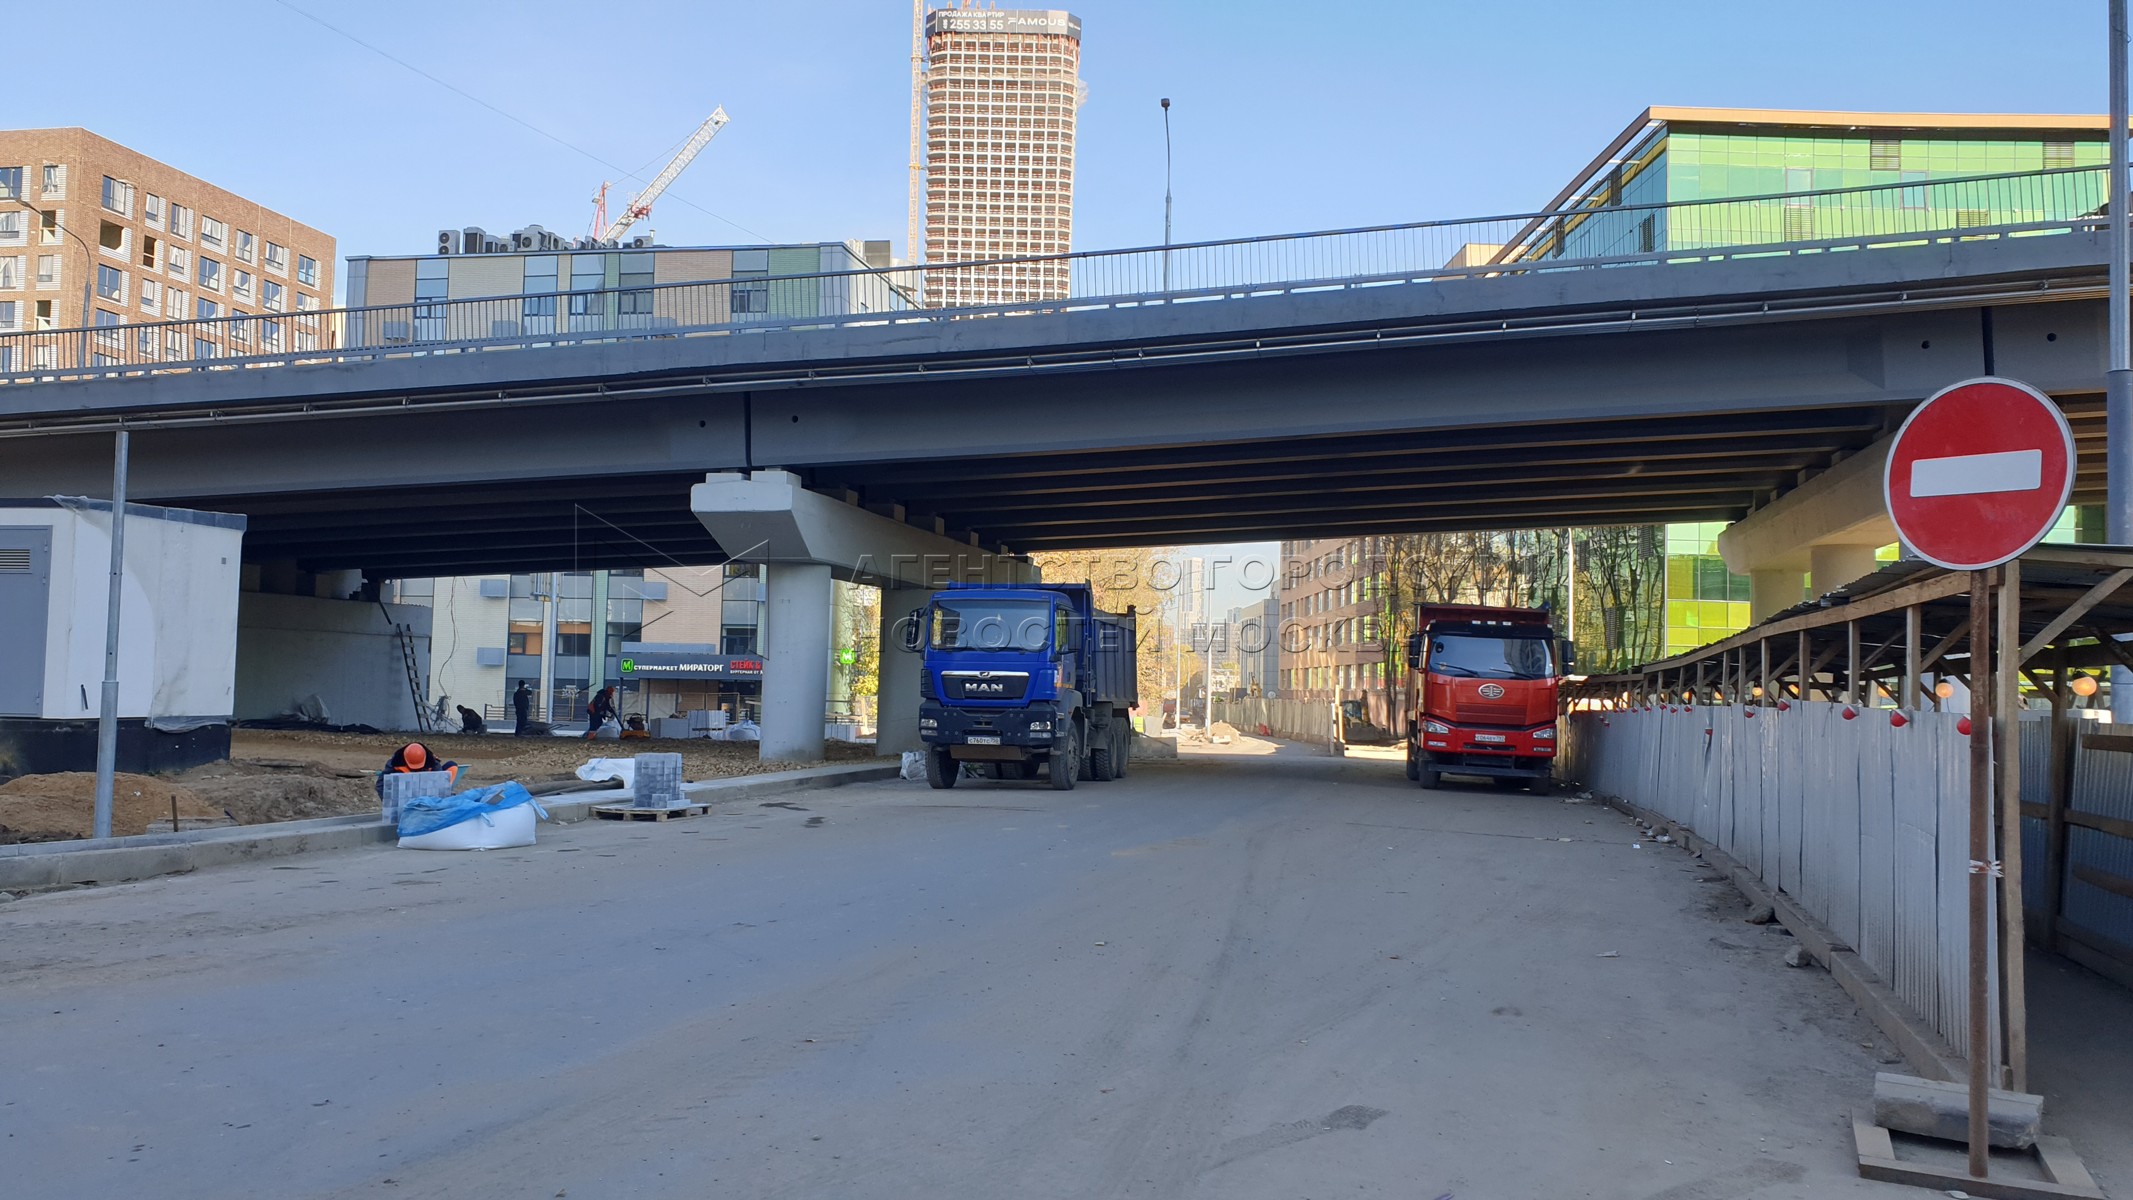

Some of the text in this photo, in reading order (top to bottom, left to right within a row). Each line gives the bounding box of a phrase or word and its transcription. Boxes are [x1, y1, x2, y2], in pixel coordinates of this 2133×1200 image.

[949, 19, 971, 30] 255
[972, 19, 986, 30] 33
[990, 20, 1004, 30] 55
[1008, 17, 1066, 27] FAMOUS
[679, 664, 724, 672] МИРАТОРГ
[730, 660, 753, 670] СТЕЙК
[965, 683, 1003, 692] MAN
